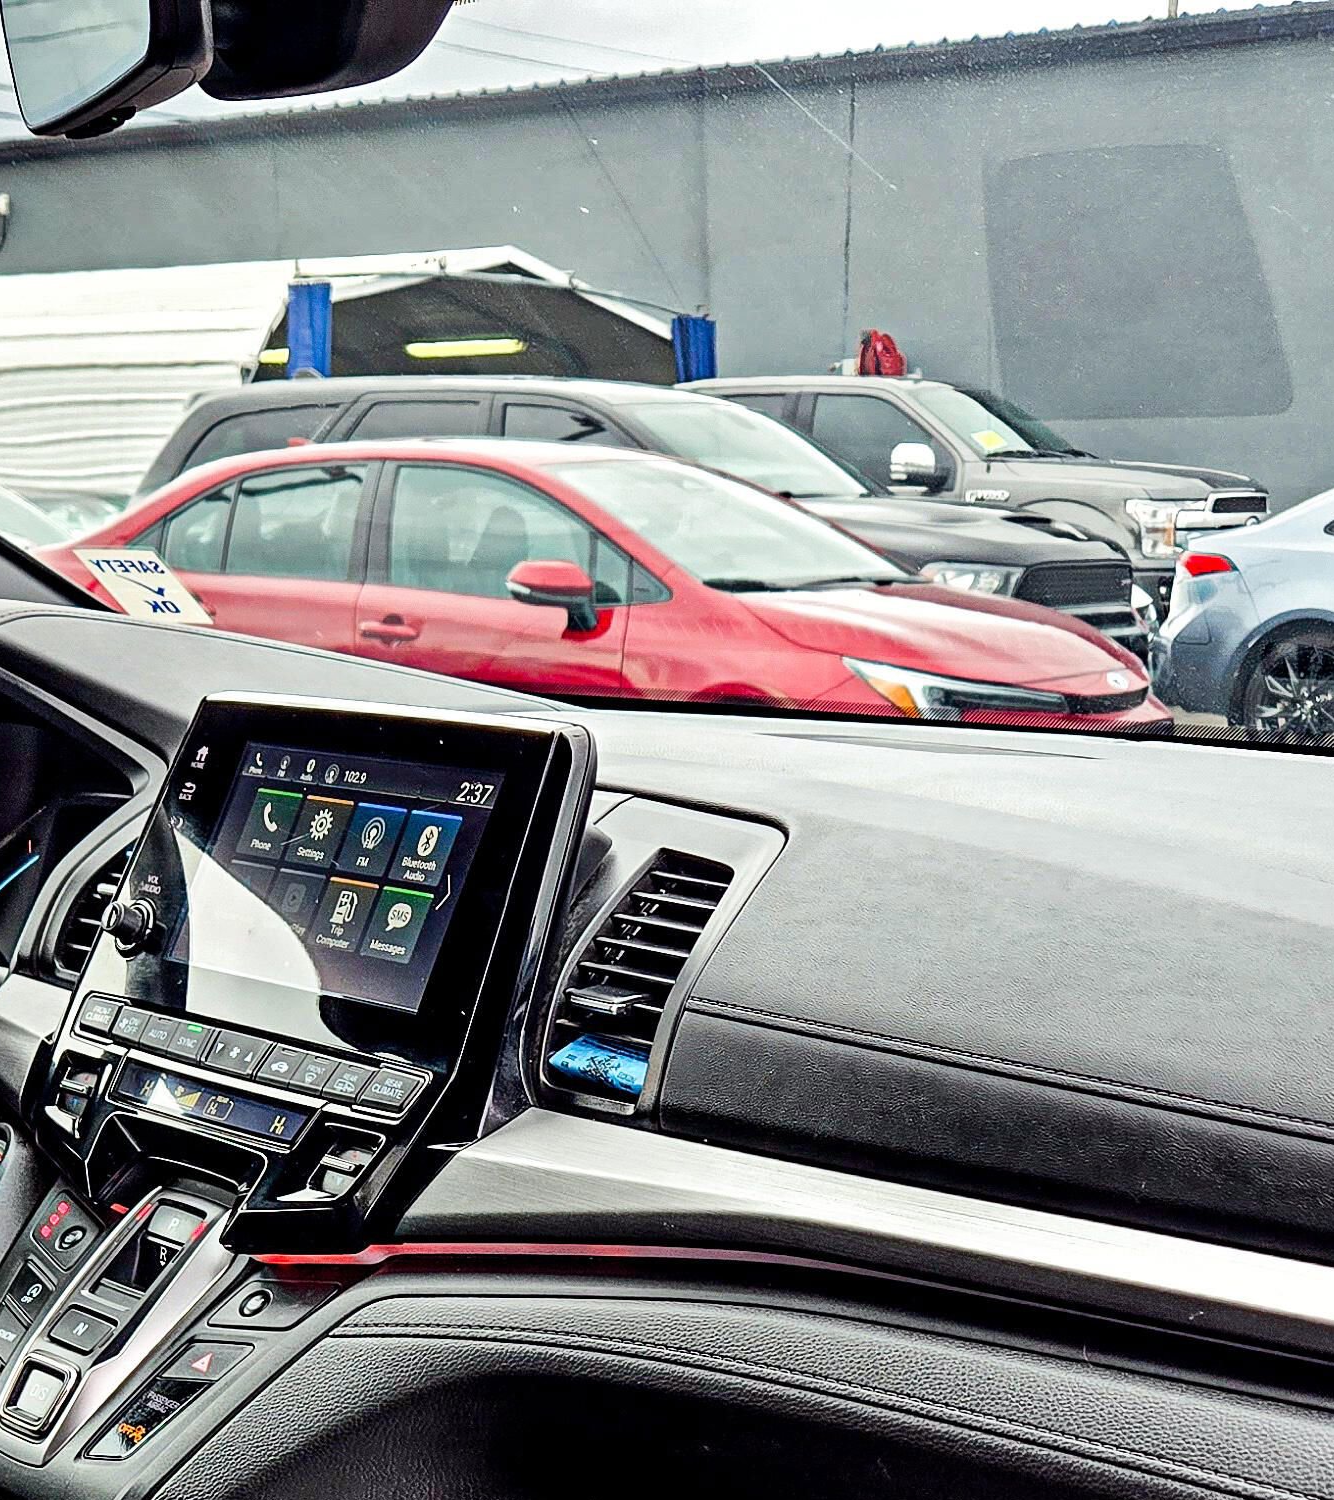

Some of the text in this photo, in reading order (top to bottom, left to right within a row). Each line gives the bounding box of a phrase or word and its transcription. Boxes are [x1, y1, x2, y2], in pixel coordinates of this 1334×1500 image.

[343, 770, 367, 784] 102.9
[455, 781, 495, 805] 2:37
[250, 838, 272, 851] Phone
[296, 847, 324, 861] Settings
[355, 856, 369, 867] FM
[401, 856, 437, 872] Bluetooth
[403, 870, 426, 882] Audio
[390, 910, 410, 923] SMS
[330, 925, 344, 937] Trip
[316, 934, 350, 949] Computer
[369, 939, 406, 956] Messages
[123, 1025, 139, 1035] OFF
[148, 1029, 168, 1040] AUTO
[177, 1036, 198, 1048] SYNC
[385, 1078, 403, 1089] REAR
[372, 1083, 405, 1099] CLIMATE
[167, 1217, 180, 1231] P
[159, 1246, 168, 1262] R
[72, 1322, 89, 1337] N
